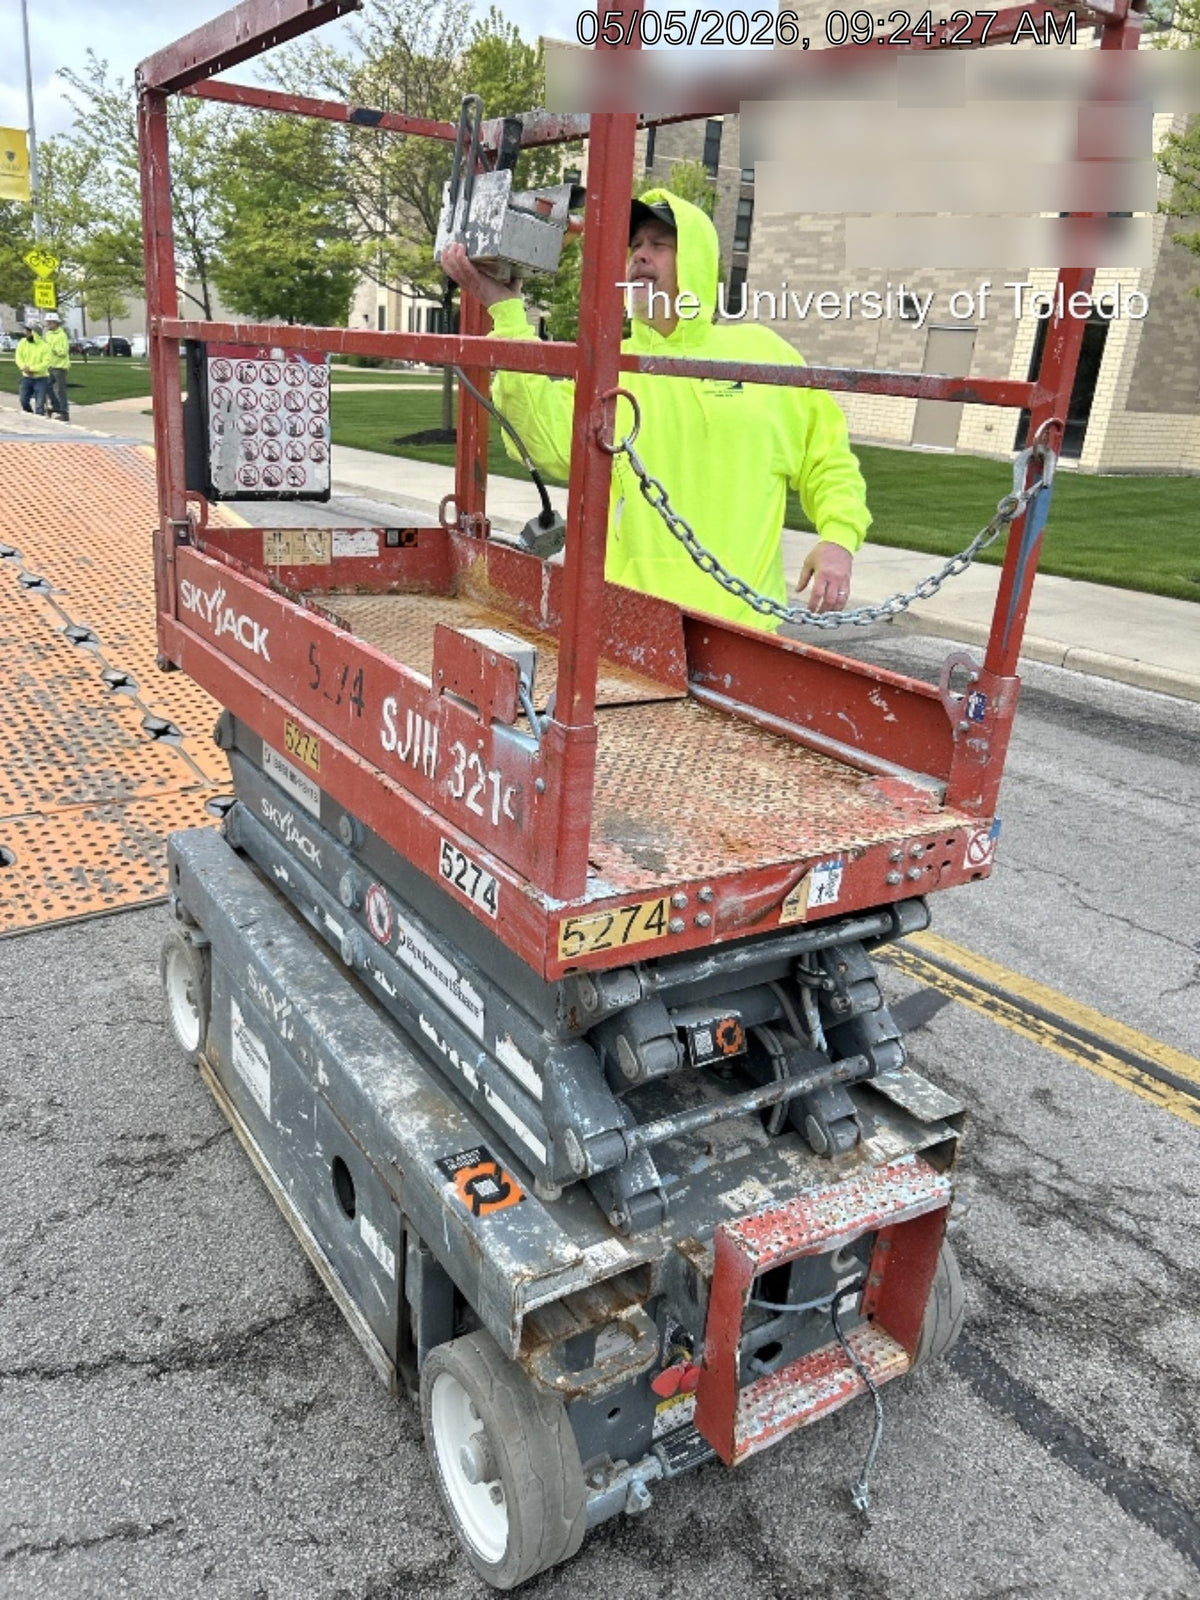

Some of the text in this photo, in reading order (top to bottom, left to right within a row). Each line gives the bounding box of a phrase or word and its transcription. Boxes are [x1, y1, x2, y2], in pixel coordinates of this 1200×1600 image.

[181, 579, 271, 663] SKYJACK
[285, 721, 319, 770] 5274
[261, 797, 322, 869] SKYJACK
[442, 842, 496, 914] 5274
[561, 899, 667, 956] 5274
